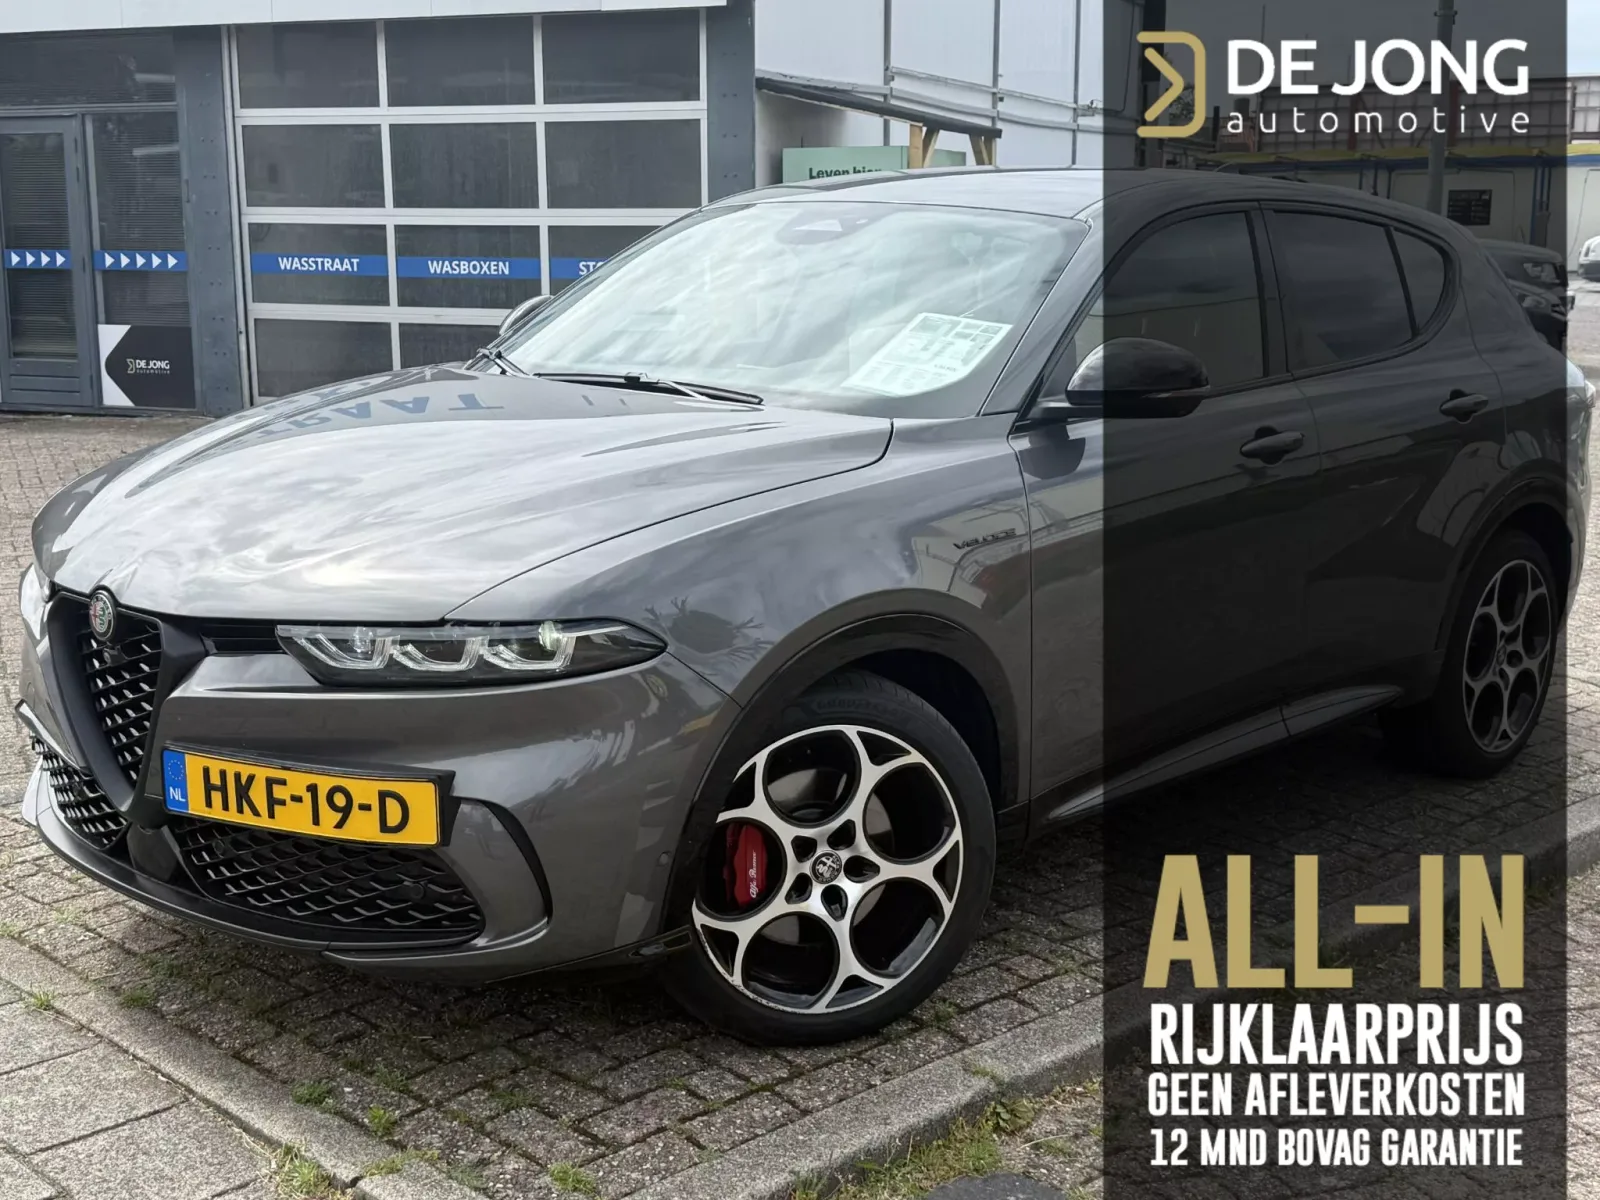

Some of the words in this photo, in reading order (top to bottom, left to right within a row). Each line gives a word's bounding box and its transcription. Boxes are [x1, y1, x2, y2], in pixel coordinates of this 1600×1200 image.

[278, 256, 360, 273] WASSTRAAT
[428, 259, 510, 276] WASBOXEN
[136, 359, 147, 368] DE
[147, 360, 170, 369] JONG
[169, 786, 186, 802] NL
[202, 765, 410, 834] HKF-19-D
